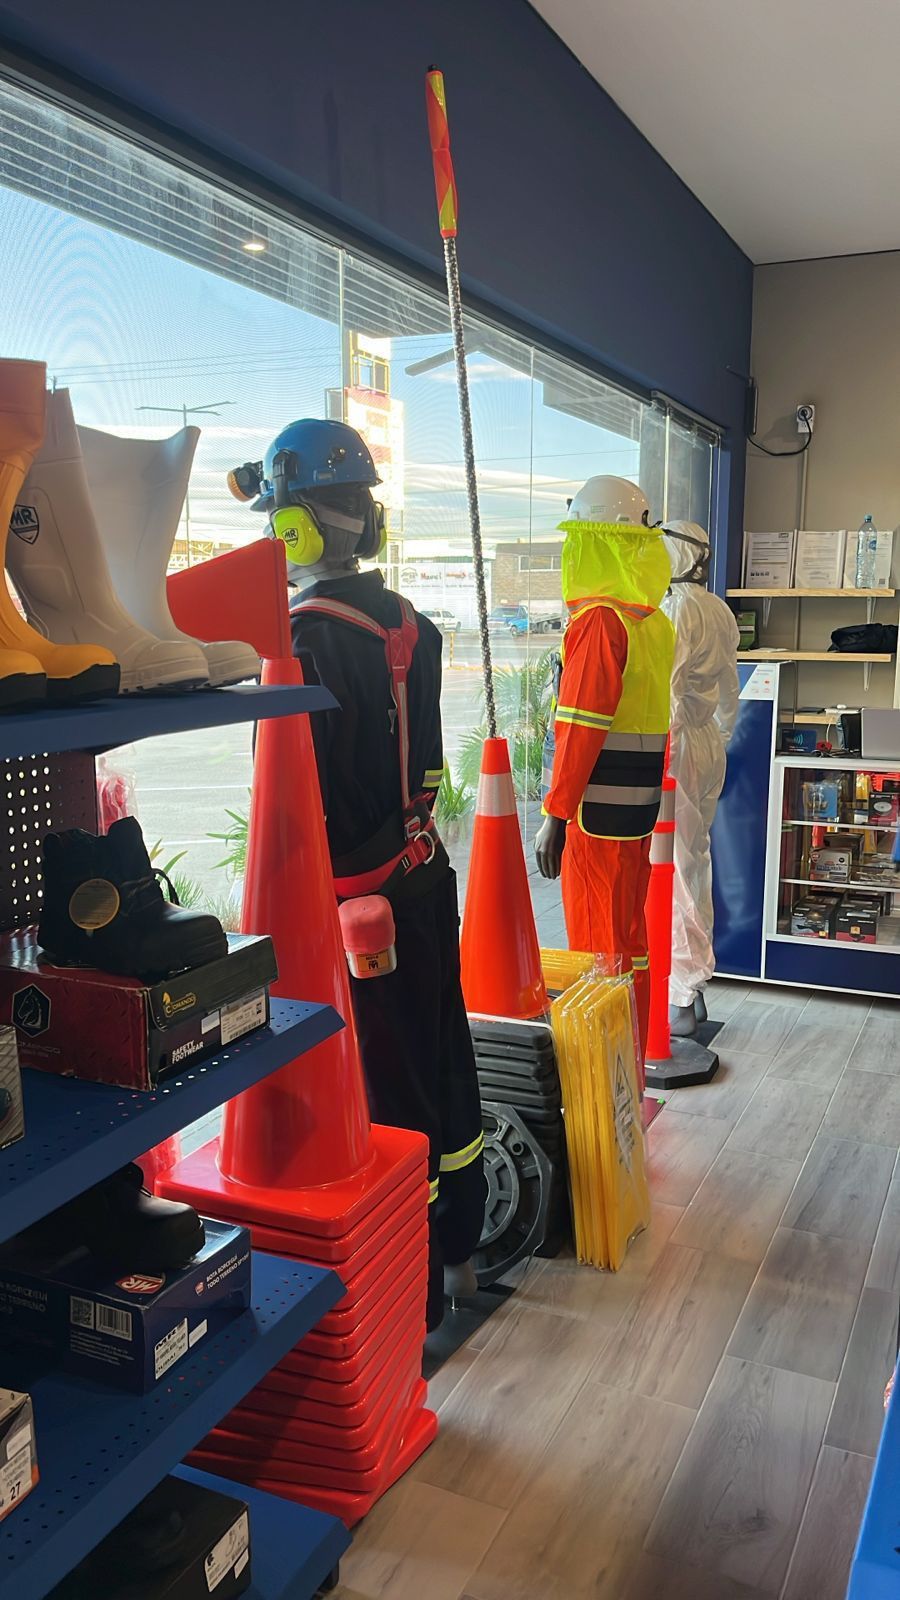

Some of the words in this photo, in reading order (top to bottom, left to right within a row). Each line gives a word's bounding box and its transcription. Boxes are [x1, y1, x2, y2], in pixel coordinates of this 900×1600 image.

[14, 508, 36, 526] MR
[284, 529, 297, 538] MR
[172, 1040, 195, 1056] SAFETY
[172, 1041, 204, 1064] FOOTWEAR
[206, 1270, 218, 1282] BOTA
[207, 1277, 220, 1289] TODO
[121, 1277, 155, 1291] MR
[10, 1481, 21, 1501] 27
